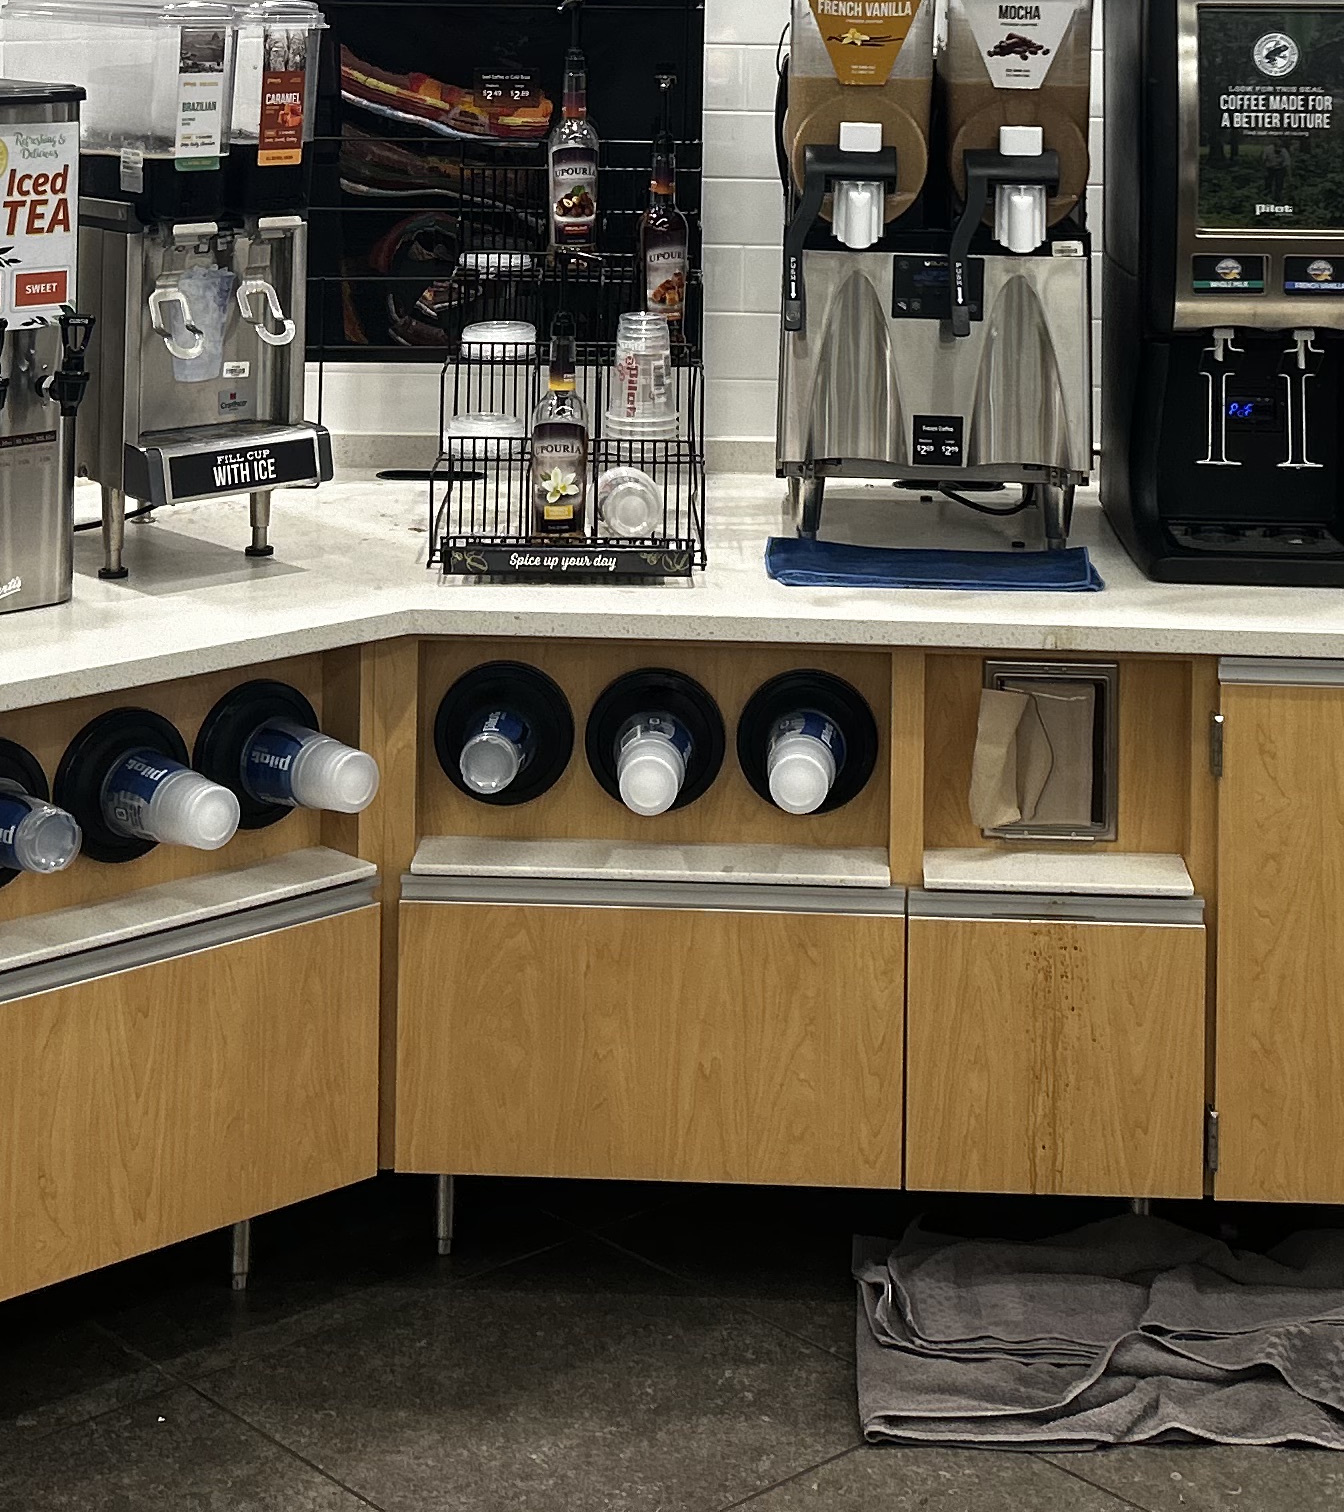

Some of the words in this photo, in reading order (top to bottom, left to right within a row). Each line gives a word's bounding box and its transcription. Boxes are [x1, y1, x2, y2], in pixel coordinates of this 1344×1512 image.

[817, 0, 862, 16] FRENCH
[865, 0, 912, 17] VANILLA
[998, 5, 1041, 20] MOCHA
[182, 101, 217, 112] BRAZILIAN
[266, 93, 301, 105] CARAMEL
[1220, 95, 1266, 110] COFFEE
[1269, 95, 1304, 110] MADE
[1308, 95, 1333, 111] FOR
[1221, 112, 1231, 127] A
[1233, 112, 1280, 128] BETTER
[1284, 113, 1331, 128] FUTURE
[6, 164, 69, 196] Iced
[2, 198, 71, 236] TEA
[25, 282, 57, 294] SWEET
[216, 454, 244, 464] FILL
[246, 449, 270, 460] CUP
[213, 464, 251, 487] WITH
[254, 458, 277, 480] ICE
[509, 553, 541, 570] Spice
[543, 555, 559, 570] up
[561, 555, 589, 570] your
[590, 554, 617, 571] day
[251, 750, 293, 771] pilot
[126, 758, 168, 780] pilot
